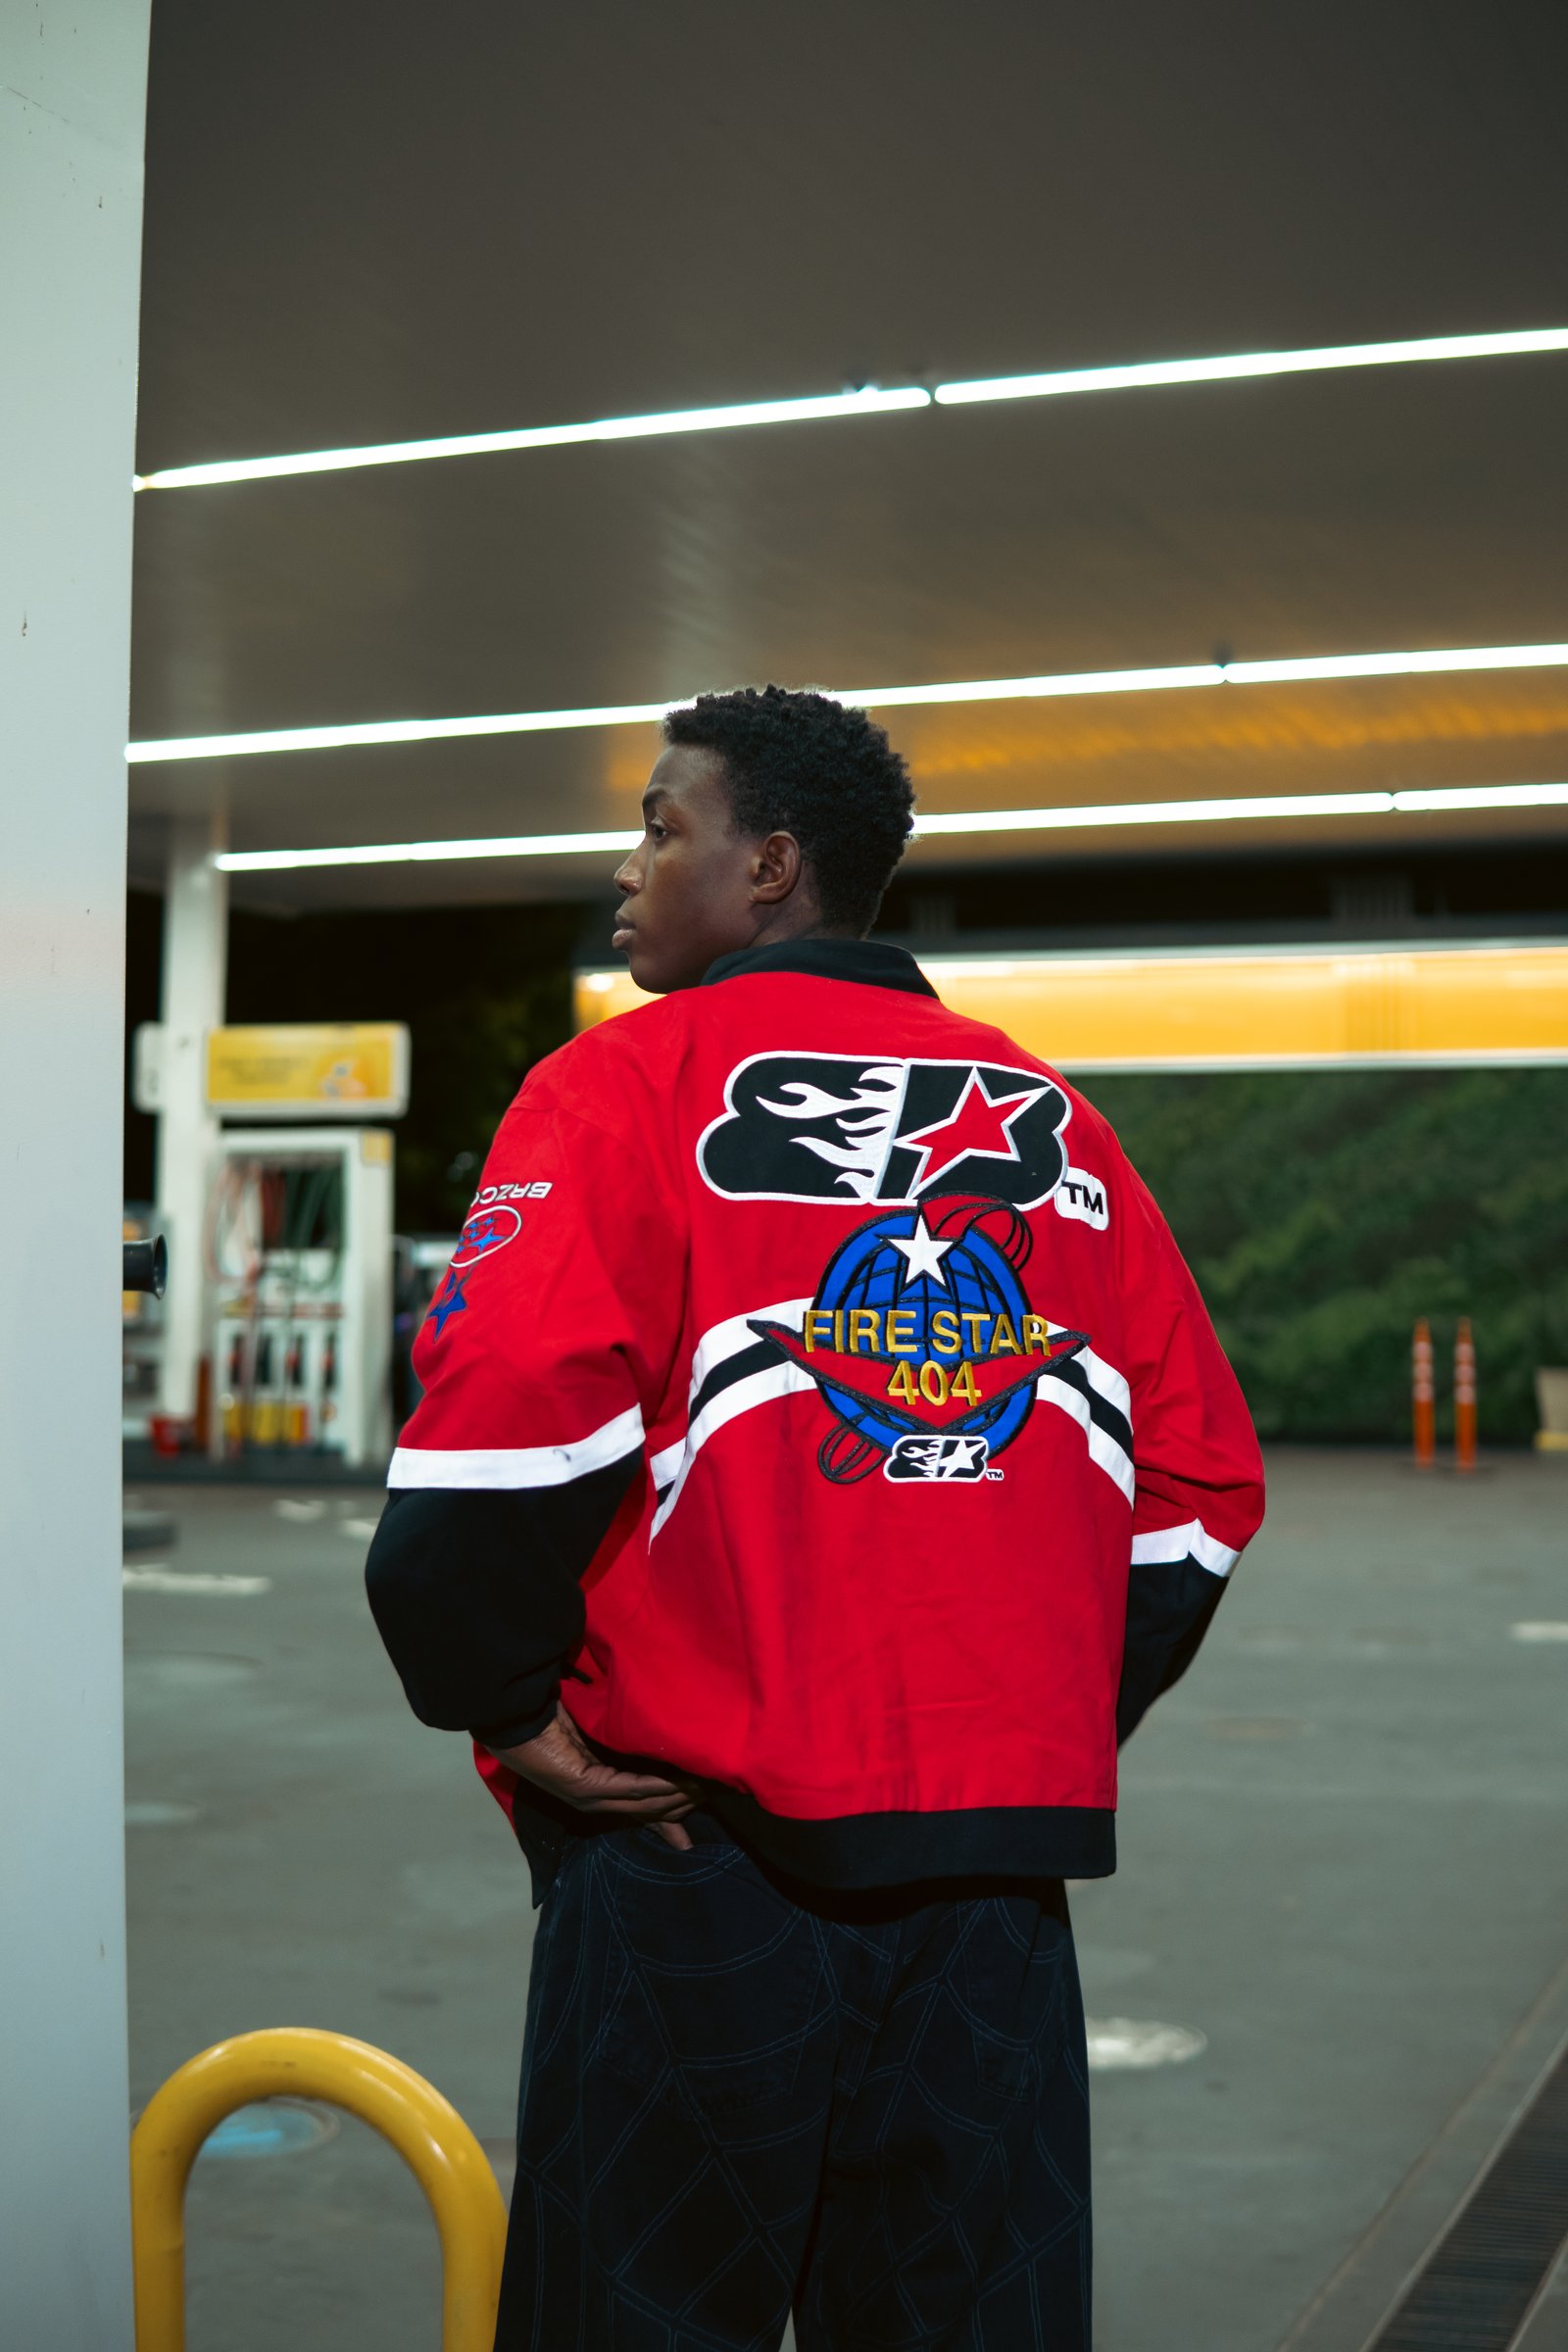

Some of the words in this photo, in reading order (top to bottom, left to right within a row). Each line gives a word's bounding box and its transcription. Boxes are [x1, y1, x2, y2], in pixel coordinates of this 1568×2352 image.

[470, 1182, 553, 1207] BRZC
[1061, 1181, 1103, 1215] TM
[803, 1309, 917, 1353] FIRE
[932, 1309, 1052, 1356] STAR
[886, 1359, 983, 1407] 404
